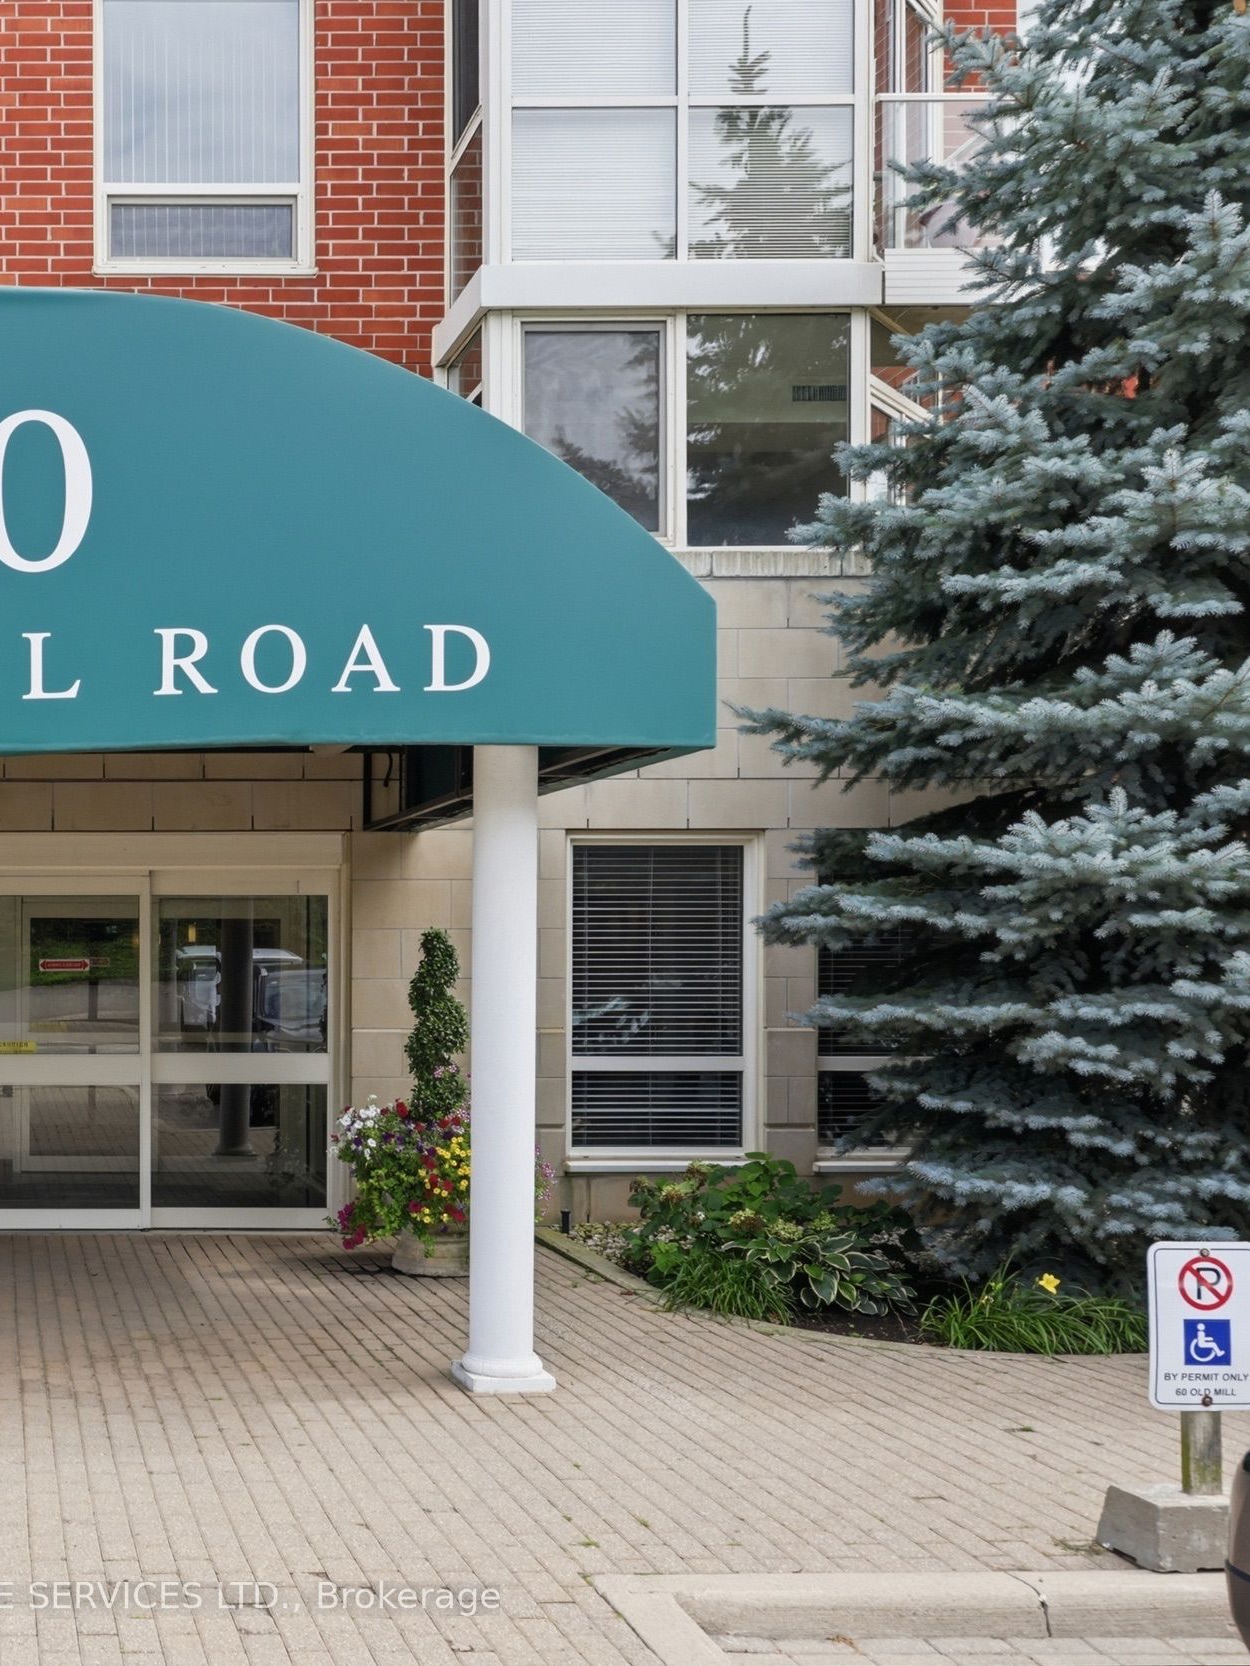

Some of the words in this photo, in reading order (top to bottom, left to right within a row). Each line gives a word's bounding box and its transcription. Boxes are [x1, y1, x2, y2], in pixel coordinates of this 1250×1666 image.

[153, 623, 491, 697] ROAD
[1164, 1372, 1178, 1381] BY
[1181, 1372, 1219, 1381] PERMIT
[1222, 1372, 1249, 1381] ONLY
[1175, 1388, 1187, 1396] 60
[1190, 1388, 1211, 1396] OLD
[1214, 1388, 1236, 1396] MILL
